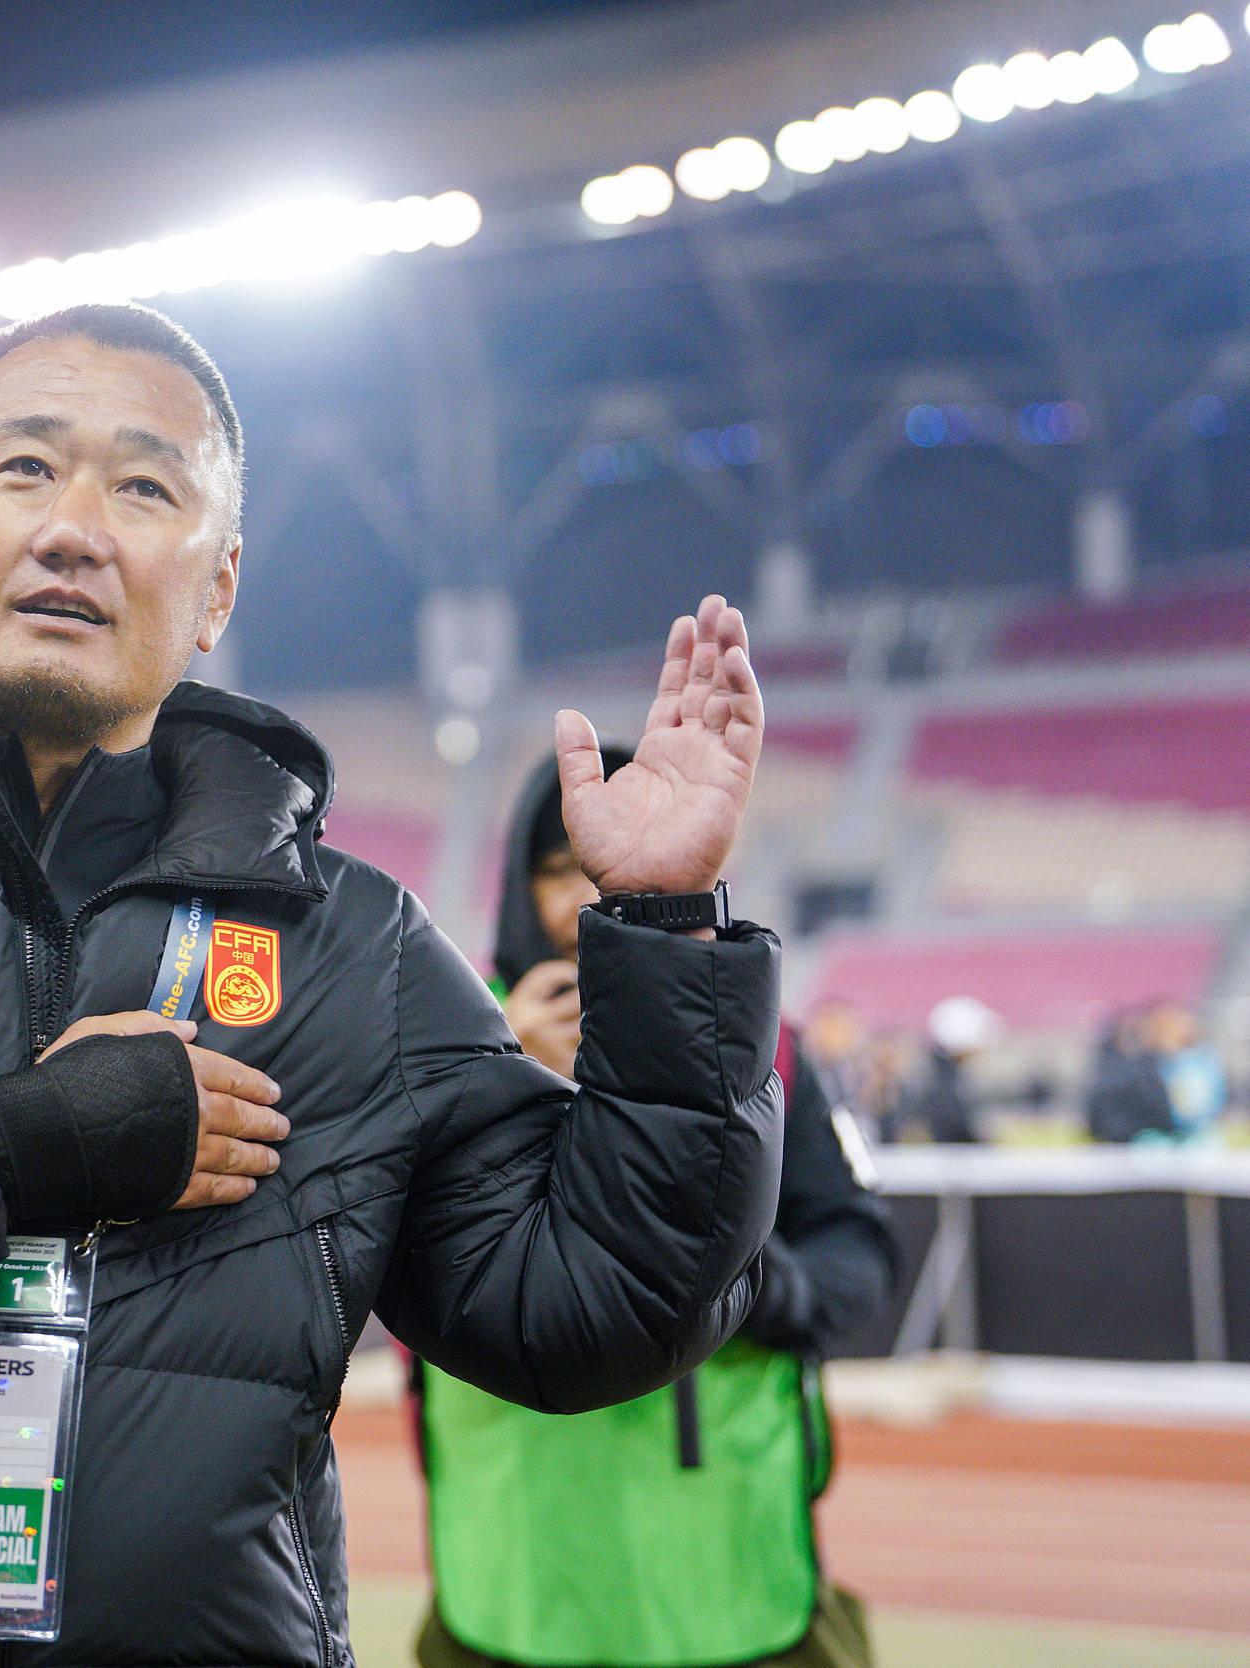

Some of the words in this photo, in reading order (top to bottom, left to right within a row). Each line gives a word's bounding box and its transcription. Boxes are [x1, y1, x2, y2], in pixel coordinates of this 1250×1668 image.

[214, 928, 271, 955] CFA
[161, 897, 203, 1018] the-AFC.com
[232, 950, 254, 965] 中国
[11, 1277, 24, 1302] 1
